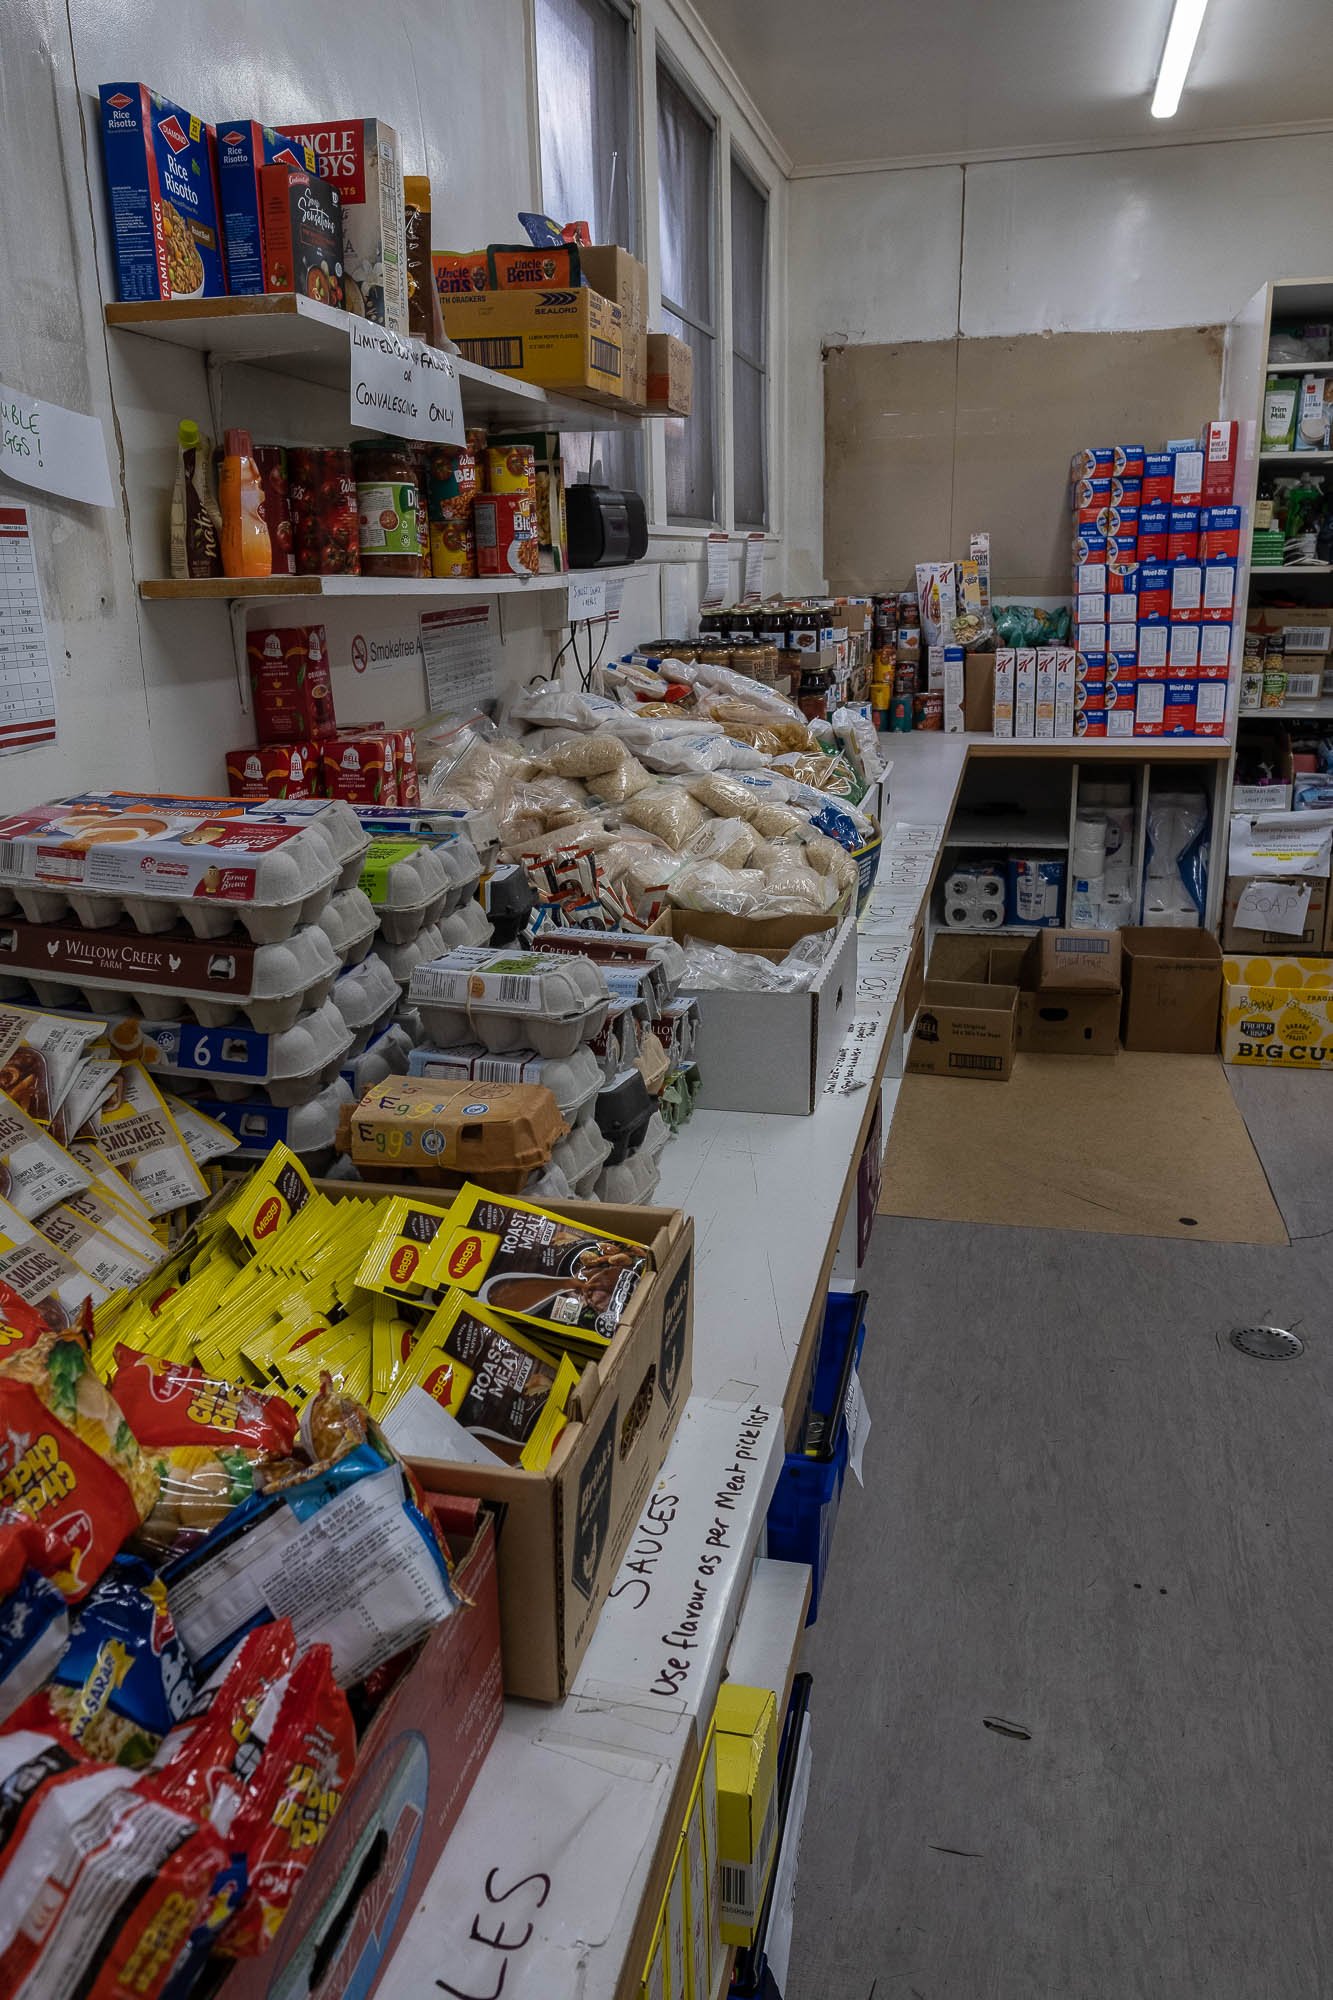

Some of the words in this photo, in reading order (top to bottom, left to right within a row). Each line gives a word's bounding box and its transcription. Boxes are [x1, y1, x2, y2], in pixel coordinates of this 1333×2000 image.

[108, 120, 136, 129] Risotto
[162, 125, 186, 144] DIAMOND
[168, 154, 188, 181] Rice
[224, 155, 248, 163] Risotto
[165, 172, 198, 205] Risotto
[154, 202, 164, 240] PACK
[159, 246, 170, 297] FAMILY
[438, 267, 469, 279] Uncle
[514, 259, 542, 269] Uncle
[535, 306, 577, 315] SEALORD
[354, 326, 393, 354] LIMITED
[404, 370, 412, 382] OR
[429, 403, 454, 428] ONLY
[1, 432, 31, 457] GGS
[940, 568, 952, 584] K
[309, 641, 320, 652] BELL
[370, 637, 414, 661] Smokefree
[997, 657, 1012, 673] K
[1018, 657, 1034, 672] K
[1039, 657, 1054, 673] K
[1058, 657, 1073, 672] K
[291, 762, 301, 771] BELL
[288, 788, 309, 800] ORIGINAL
[221, 880, 246, 891] Brown
[222, 872, 248, 883] Farmer
[1243, 894, 1297, 914] SOAP
[66, 940, 118, 962] WILLOW
[122, 946, 162, 965] CREEK
[100, 960, 122, 970] FARM
[194, 1036, 211, 1066] 6
[1238, 1043, 1282, 1058] BIG
[379, 1096, 444, 1119] Eggs
[114, 1114, 150, 1130] INGREDIENTS
[10, 1133, 28, 1145] SPICES
[101, 1120, 166, 1152] SAUSAGES
[358, 1122, 413, 1158] Eggs
[119, 1147, 137, 1158] HERBS
[145, 1139, 165, 1150] SPICES
[14, 1168, 32, 1180] SIMPLY
[256, 1201, 279, 1234] Maggi
[500, 1212, 528, 1254] ROAST
[518, 1215, 543, 1250] MEAT
[543, 1224, 554, 1242] GRAVY
[396, 1250, 414, 1278] Maggi
[453, 1241, 476, 1273] Maggi
[5, 1252, 59, 1288] SAUSAGE
[32, 1277, 47, 1293] HERBS
[470, 1338, 500, 1400] ROAST
[489, 1349, 519, 1398] MEAT
[517, 1361, 530, 1387] GRAVY
[714, 1463, 747, 1510] Meat
[332, 1506, 348, 1519] BEEF
[706, 1517, 731, 1548] per
[608, 1493, 680, 1610] SAUCES
[697, 1555, 722, 1576] as
[662, 1582, 709, 1650] flavour
[650, 1658, 690, 1696] Use
[435, 1867, 552, 2000] LES
